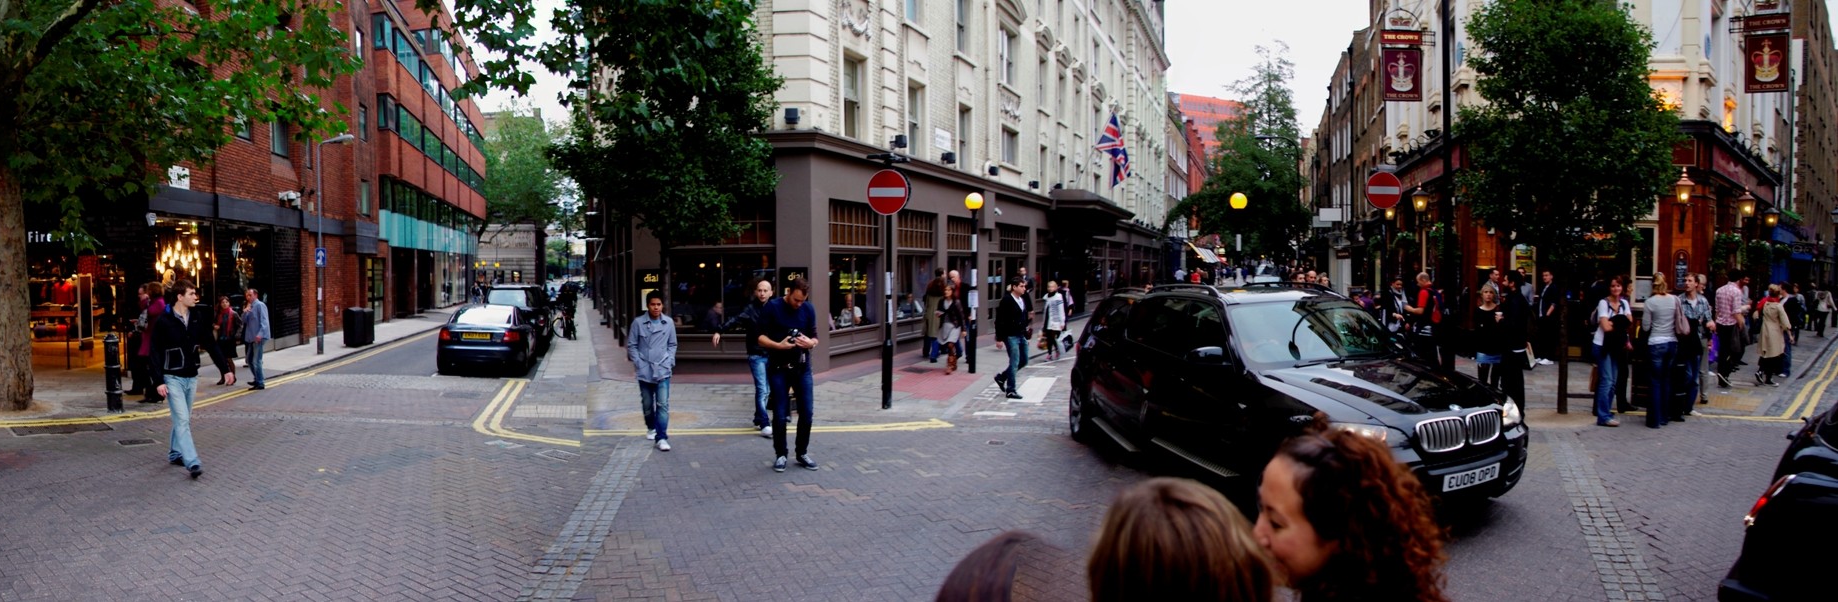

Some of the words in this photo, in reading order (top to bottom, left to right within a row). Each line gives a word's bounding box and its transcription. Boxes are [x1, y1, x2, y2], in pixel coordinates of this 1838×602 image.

[643, 273, 659, 283] dial
[787, 271, 804, 281] dial
[1448, 471, 1476, 489] EU08
[1478, 465, 1497, 482] OPD
